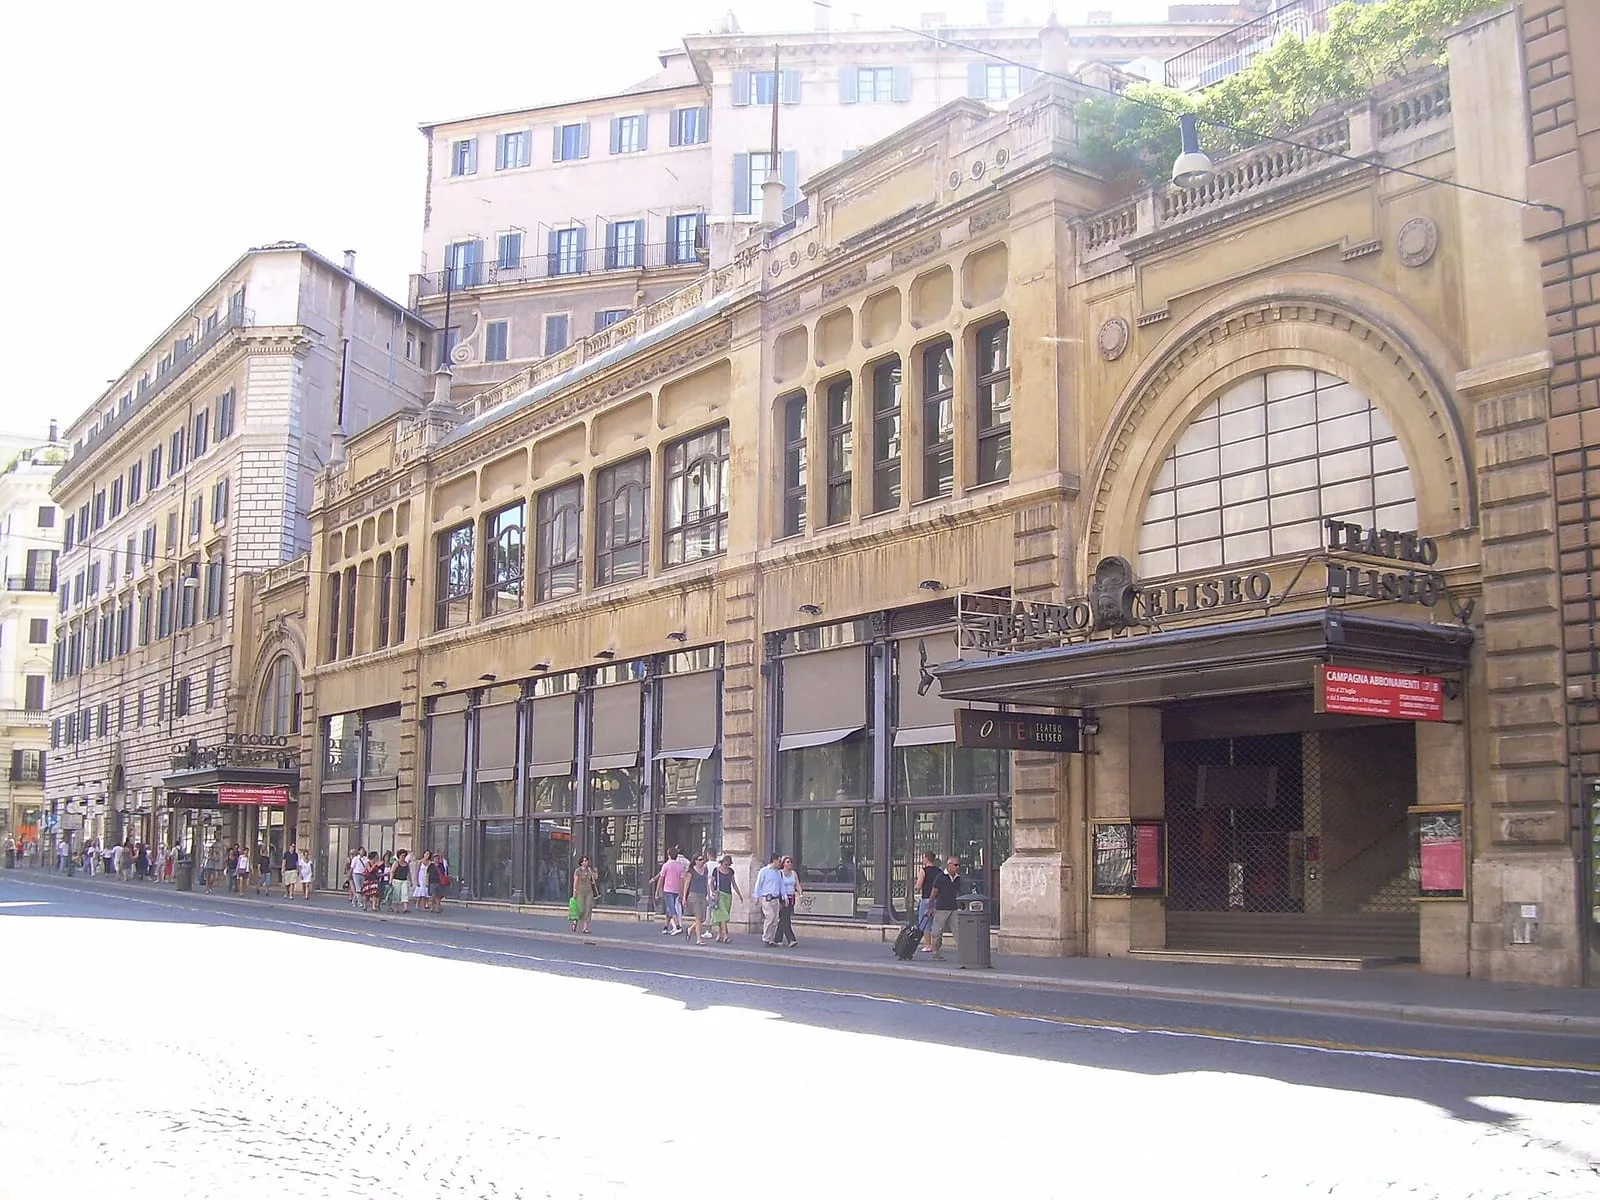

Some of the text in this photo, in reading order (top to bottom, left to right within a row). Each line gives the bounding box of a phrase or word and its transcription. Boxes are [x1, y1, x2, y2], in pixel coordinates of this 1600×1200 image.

[1325, 518, 1438, 565] TEATRO
[1326, 564, 1438, 607] LISEO
[985, 603, 1089, 642] TEATRO
[1142, 572, 1272, 616] ELISEO
[1326, 671, 1369, 684] CAMPAGNA
[1369, 675, 1420, 690] ABBONAMENTI
[1004, 721, 1025, 741] TE
[1036, 723, 1063, 733] TEATRO
[226, 733, 288, 746] PICCOLO
[1036, 733, 1063, 743] ELISEO
